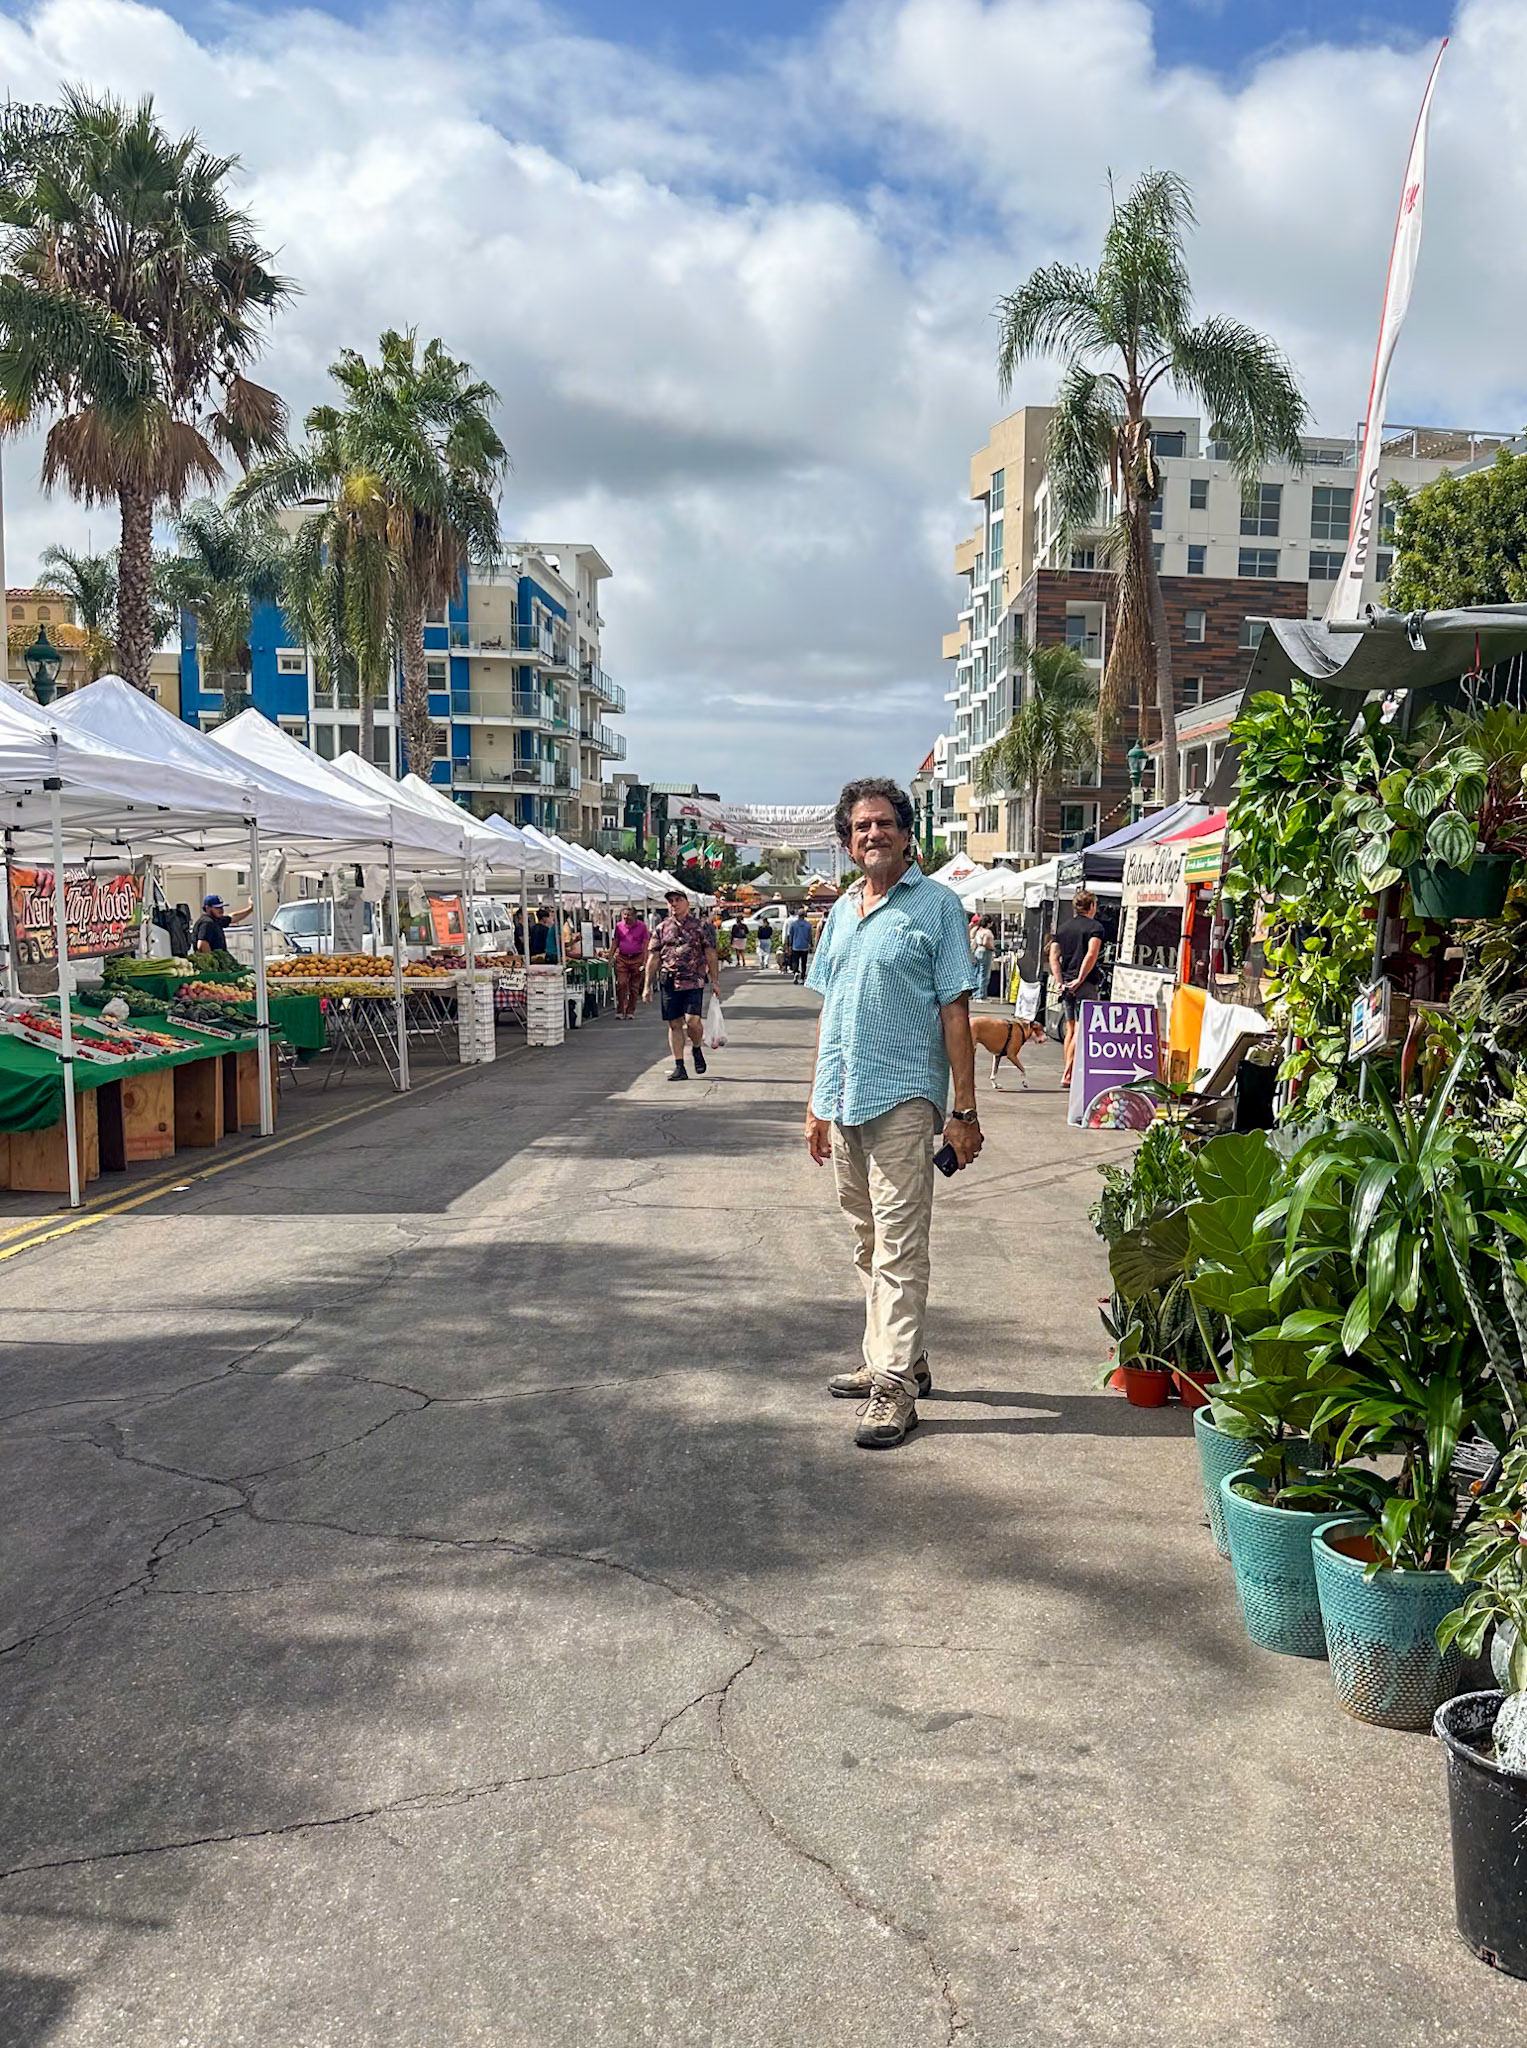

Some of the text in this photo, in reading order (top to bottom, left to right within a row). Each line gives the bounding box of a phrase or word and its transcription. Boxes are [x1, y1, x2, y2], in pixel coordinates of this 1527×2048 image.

[65, 886, 93, 933] Top
[92, 882, 136, 923] Notch
[1088, 1005, 1154, 1035] ACAI
[1088, 1034, 1154, 1060] bowls
